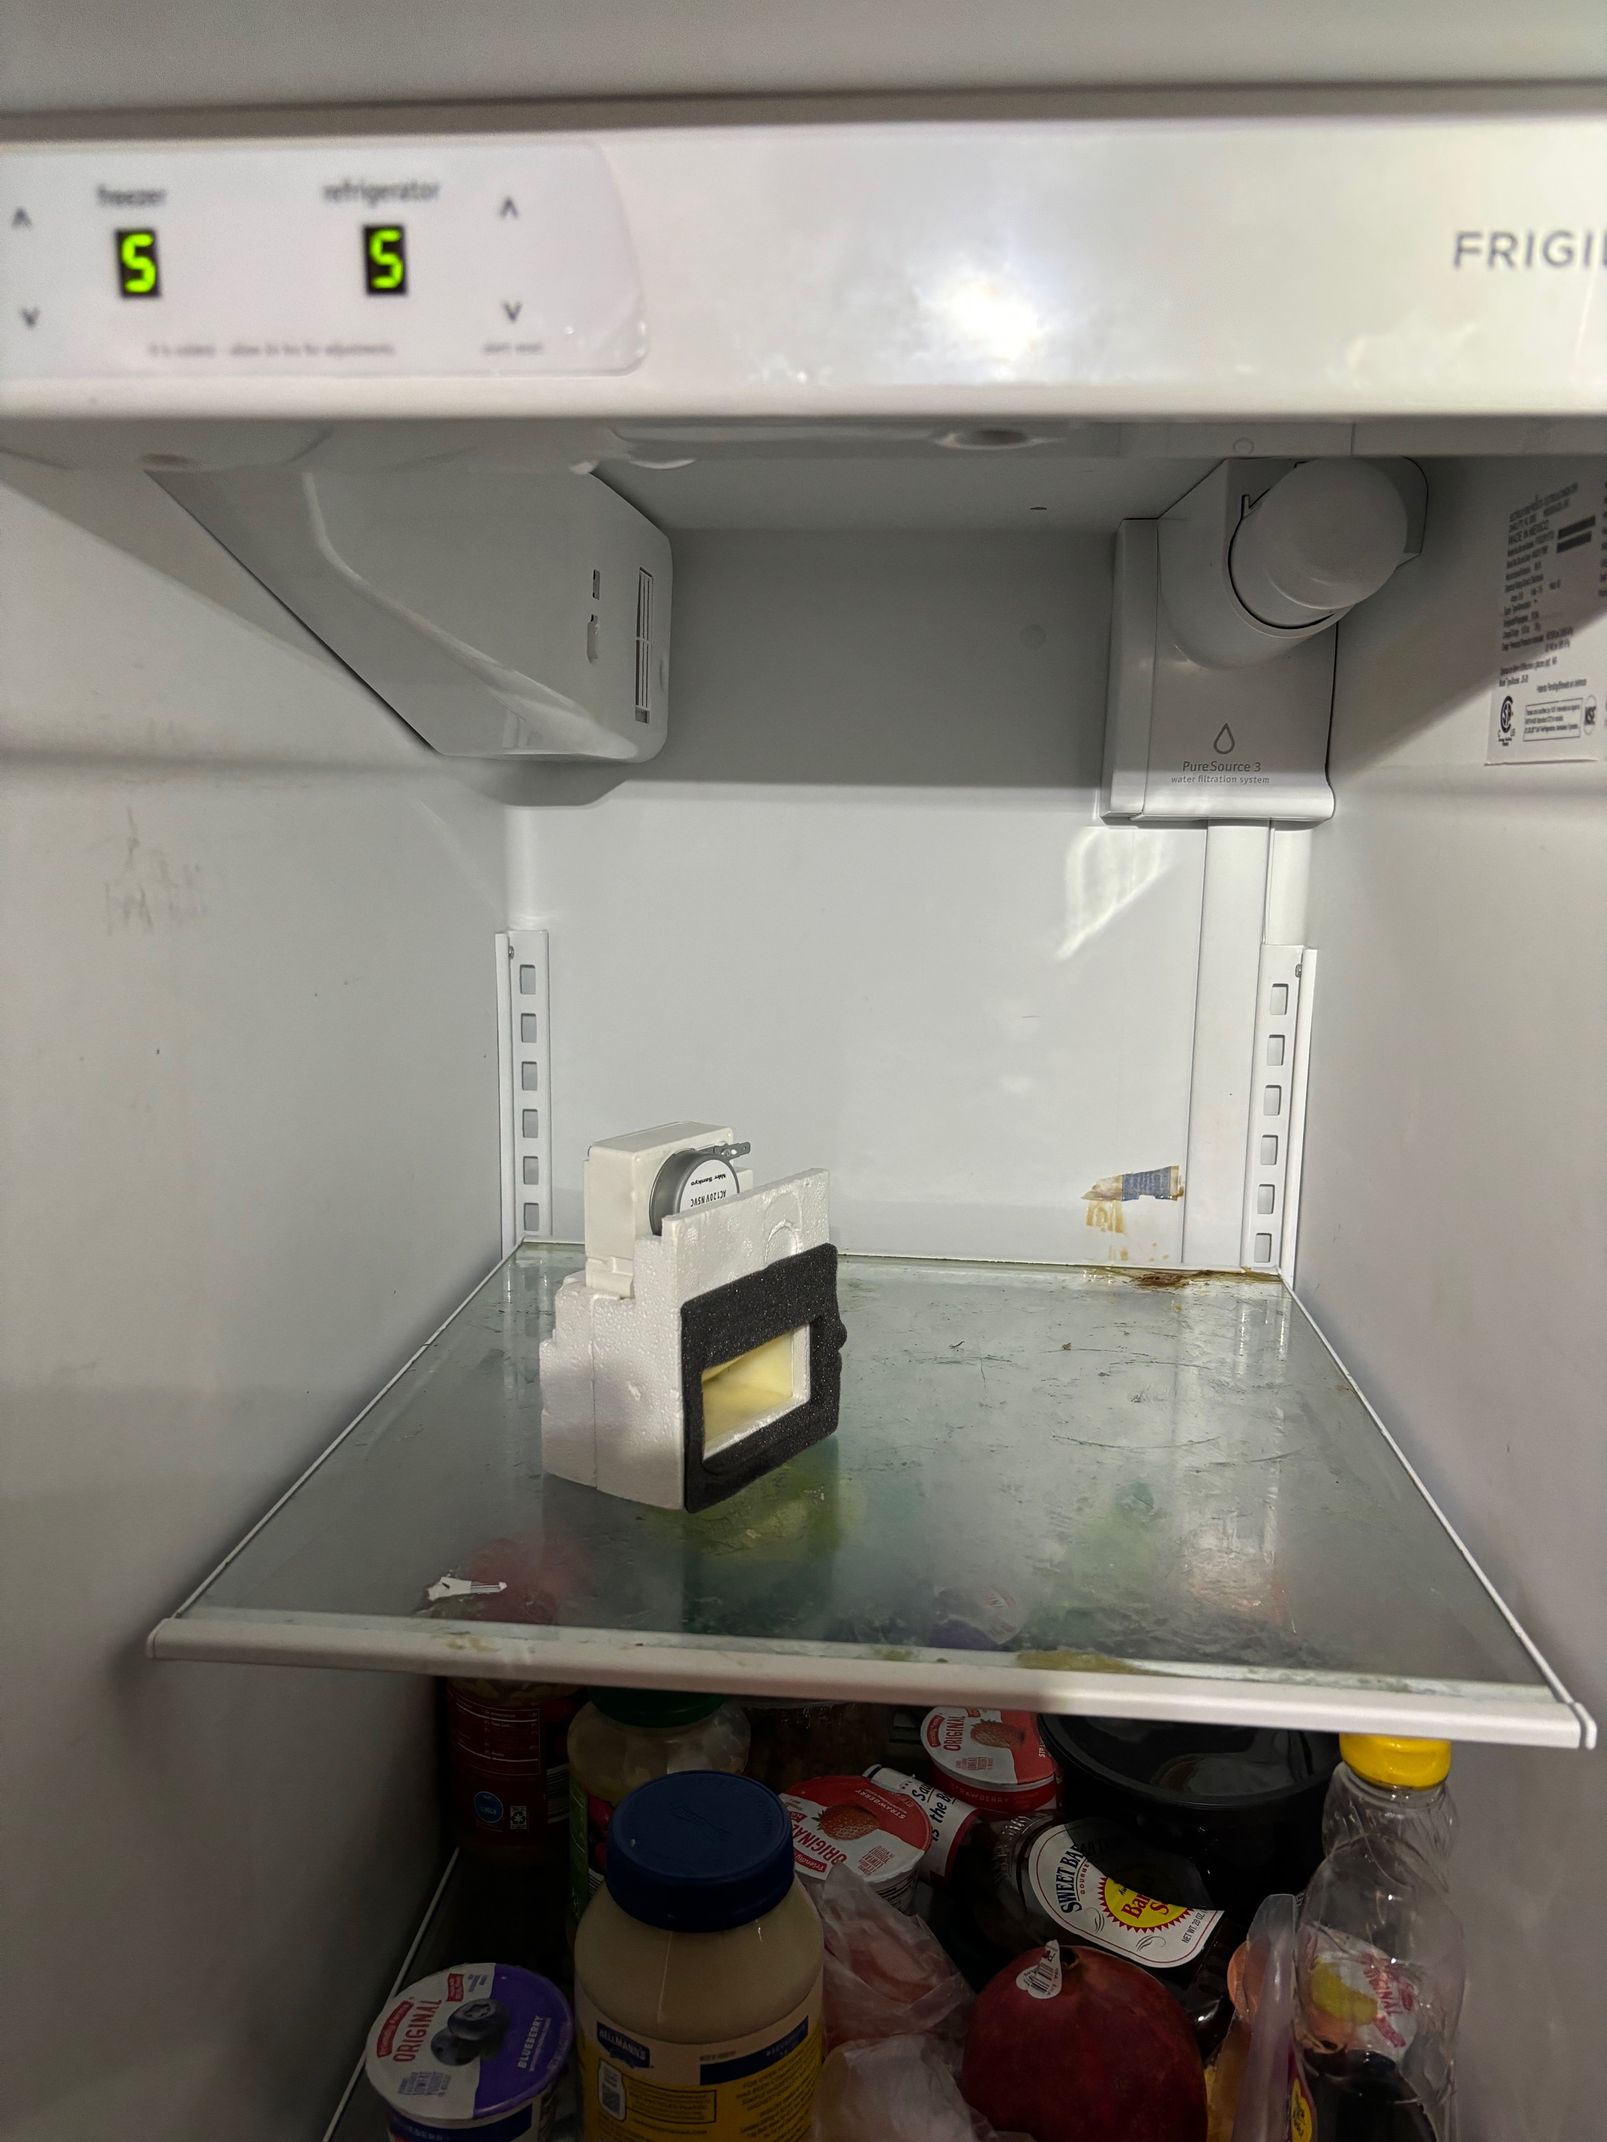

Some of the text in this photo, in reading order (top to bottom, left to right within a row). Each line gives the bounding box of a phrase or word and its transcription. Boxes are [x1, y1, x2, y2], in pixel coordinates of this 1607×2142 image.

[322, 181, 441, 207] refrigerator
[121, 233, 156, 294] 5
[370, 229, 403, 290] 5
[1452, 229, 1607, 269] FRIGI
[1171, 773, 1270, 785] water filtration system
[1182, 760, 1261, 773] PureSource 3
[943, 1715, 966, 1751] ORIGINAL
[929, 1801, 947, 1823] the
[1055, 1866, 1083, 1913] SWEET
[1079, 1863, 1090, 1895] GOURME
[393, 2000, 442, 2062] ORIGINAL
[517, 2014, 544, 2070] BLUEBERRY
